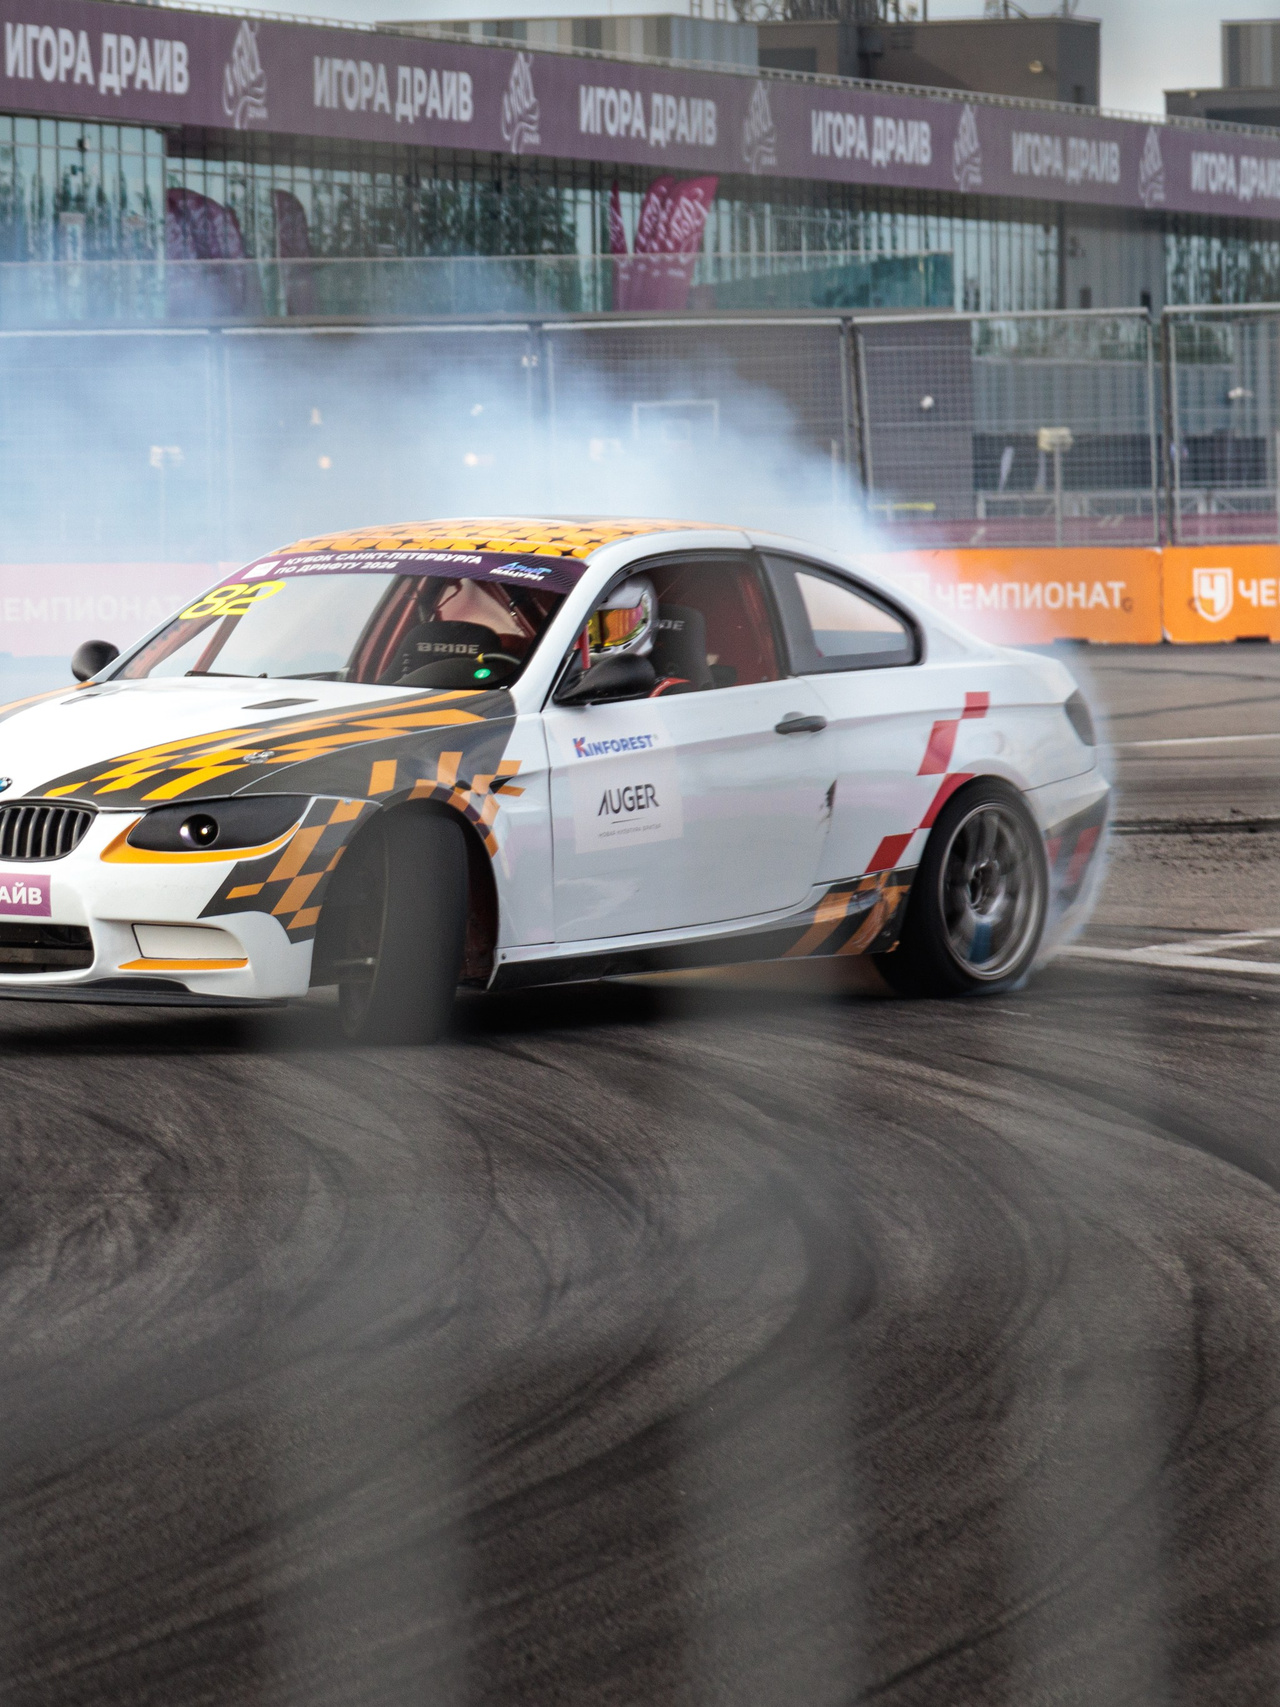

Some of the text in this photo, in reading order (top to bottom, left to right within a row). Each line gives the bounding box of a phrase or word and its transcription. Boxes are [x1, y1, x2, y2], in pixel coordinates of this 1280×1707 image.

[5, 21, 96, 86] ИГОРА
[98, 32, 190, 96] ДРАЙВ
[313, 55, 391, 114] ИГОРА
[579, 84, 647, 140] ИГОРА
[811, 109, 870, 160] ИГОРА
[273, 561, 400, 576] ПО ДРИФТУ 2026
[283, 552, 483, 567] КУБОК САНКТ-ПЕТЕРБУРГА
[178, 580, 287, 620] 82
[935, 581, 1126, 611] ЧЕМПИОНАТ
[1237, 577, 1280, 607] ЧЕ
[416, 641, 480, 654] BRIDE
[572, 734, 653, 758] KINFOREST
[597, 783, 660, 817] AUGER
